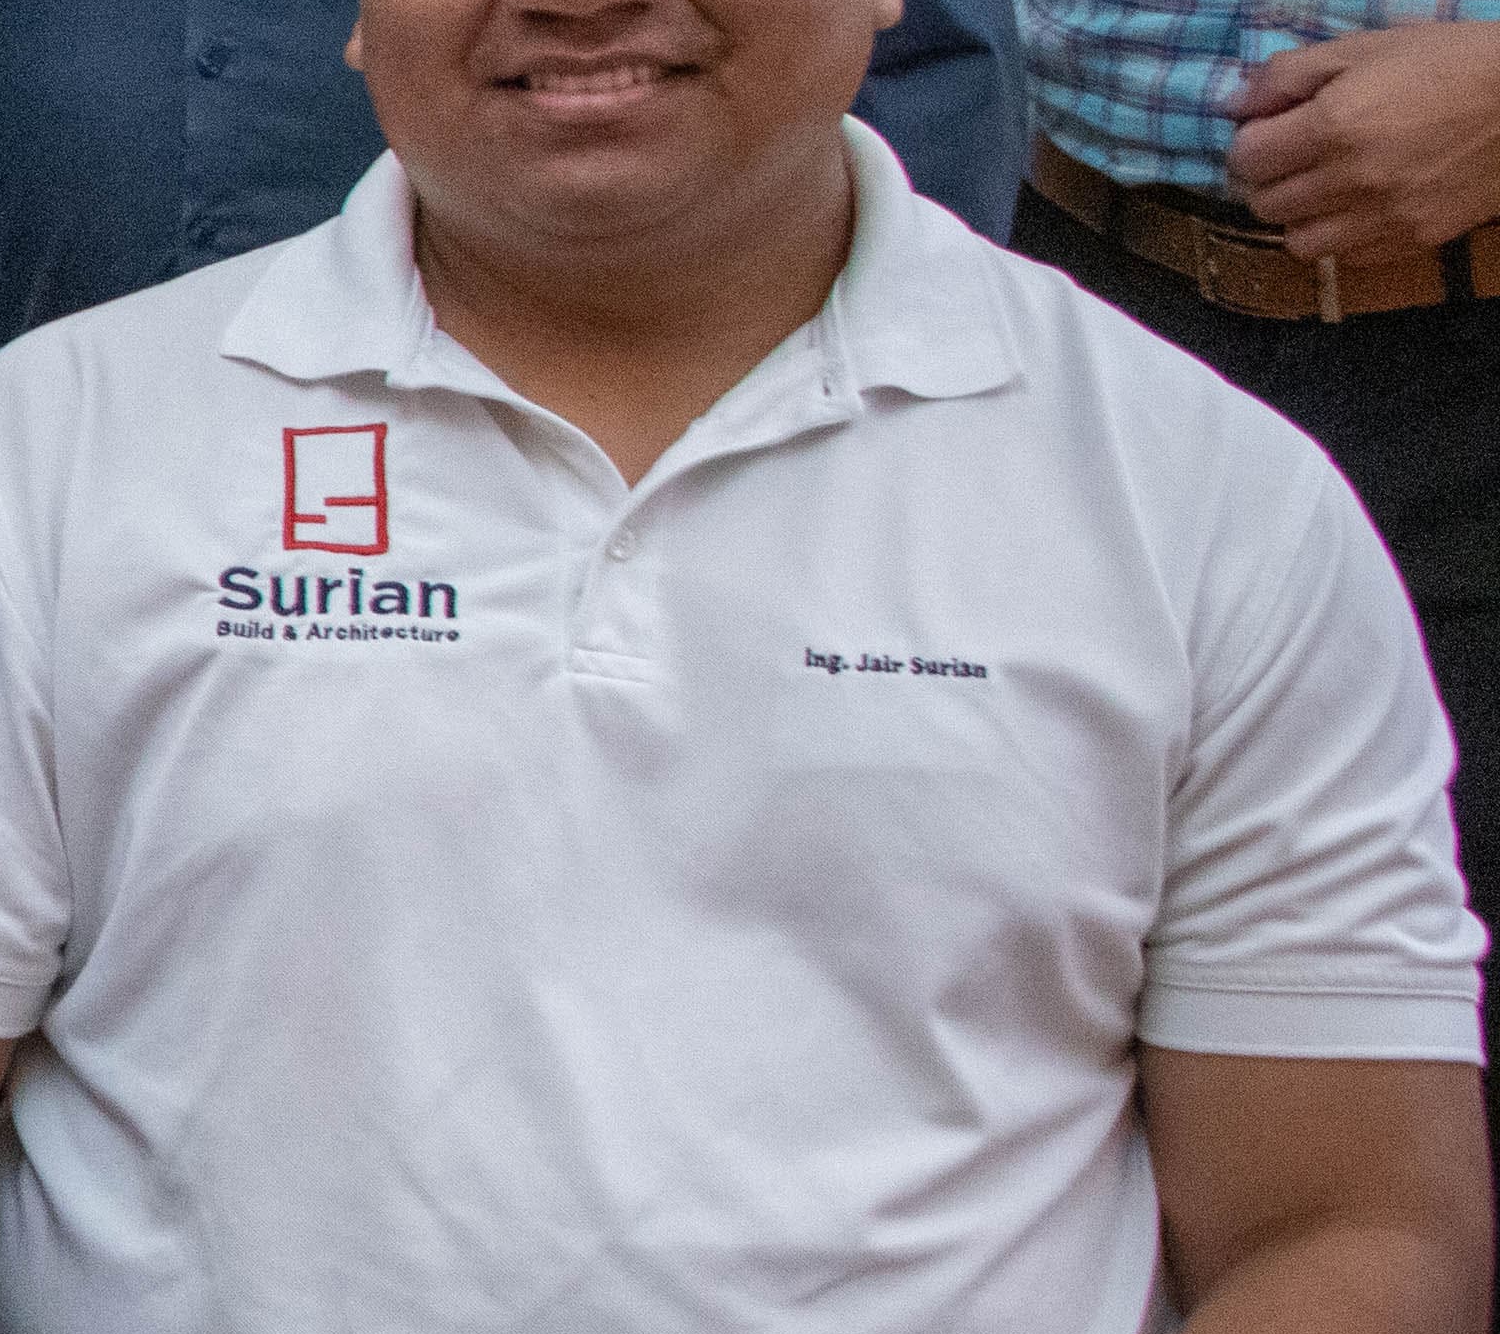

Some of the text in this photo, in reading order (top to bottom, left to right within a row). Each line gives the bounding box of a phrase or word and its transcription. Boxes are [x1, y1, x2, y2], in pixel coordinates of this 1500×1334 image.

[218, 567, 457, 618] Surian
[216, 621, 460, 642] Build & Architecture
[804, 647, 987, 678] Ing. Jair Surian
